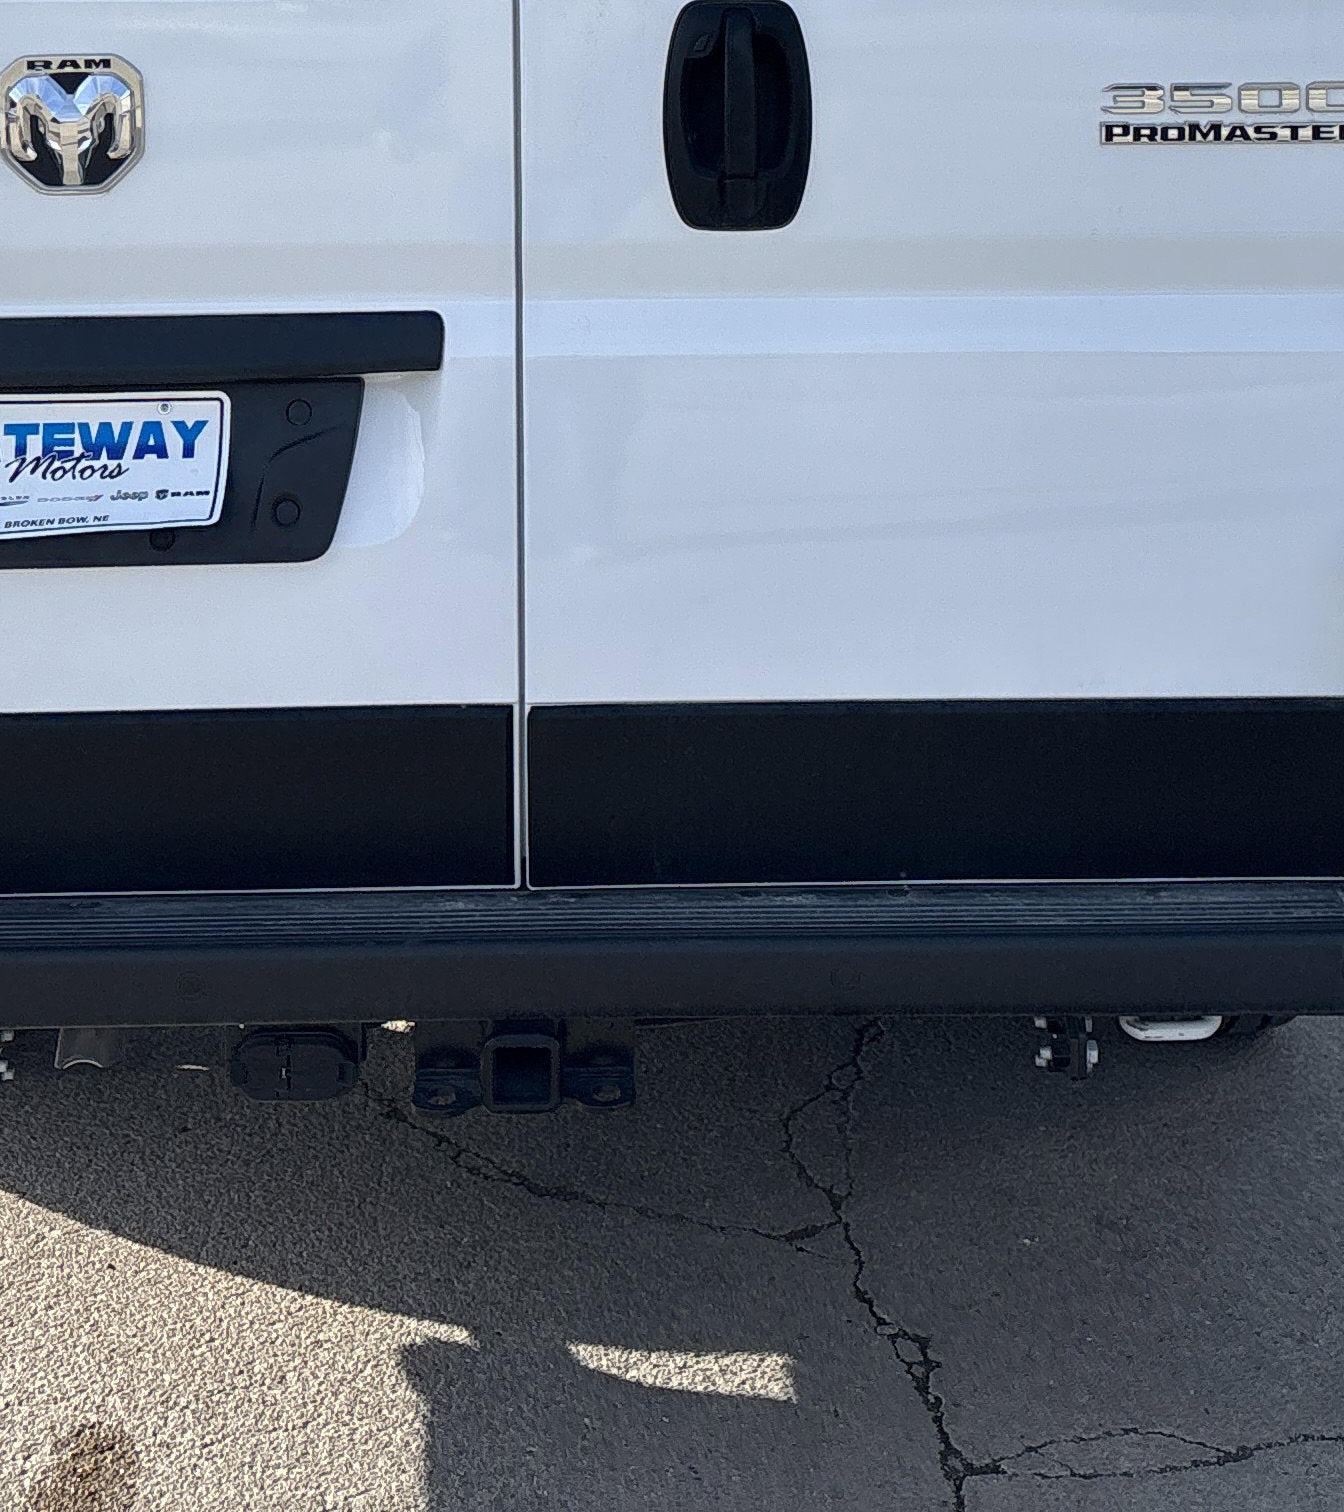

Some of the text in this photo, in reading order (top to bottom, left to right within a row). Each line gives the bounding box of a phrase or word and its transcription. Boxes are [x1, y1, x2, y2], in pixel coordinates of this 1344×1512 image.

[27, 59, 111, 71] RAM
[4, 450, 131, 484] Motors
[109, 489, 149, 502] Jeep
[3, 518, 56, 529] BROKEN
[92, 514, 110, 523] NE
